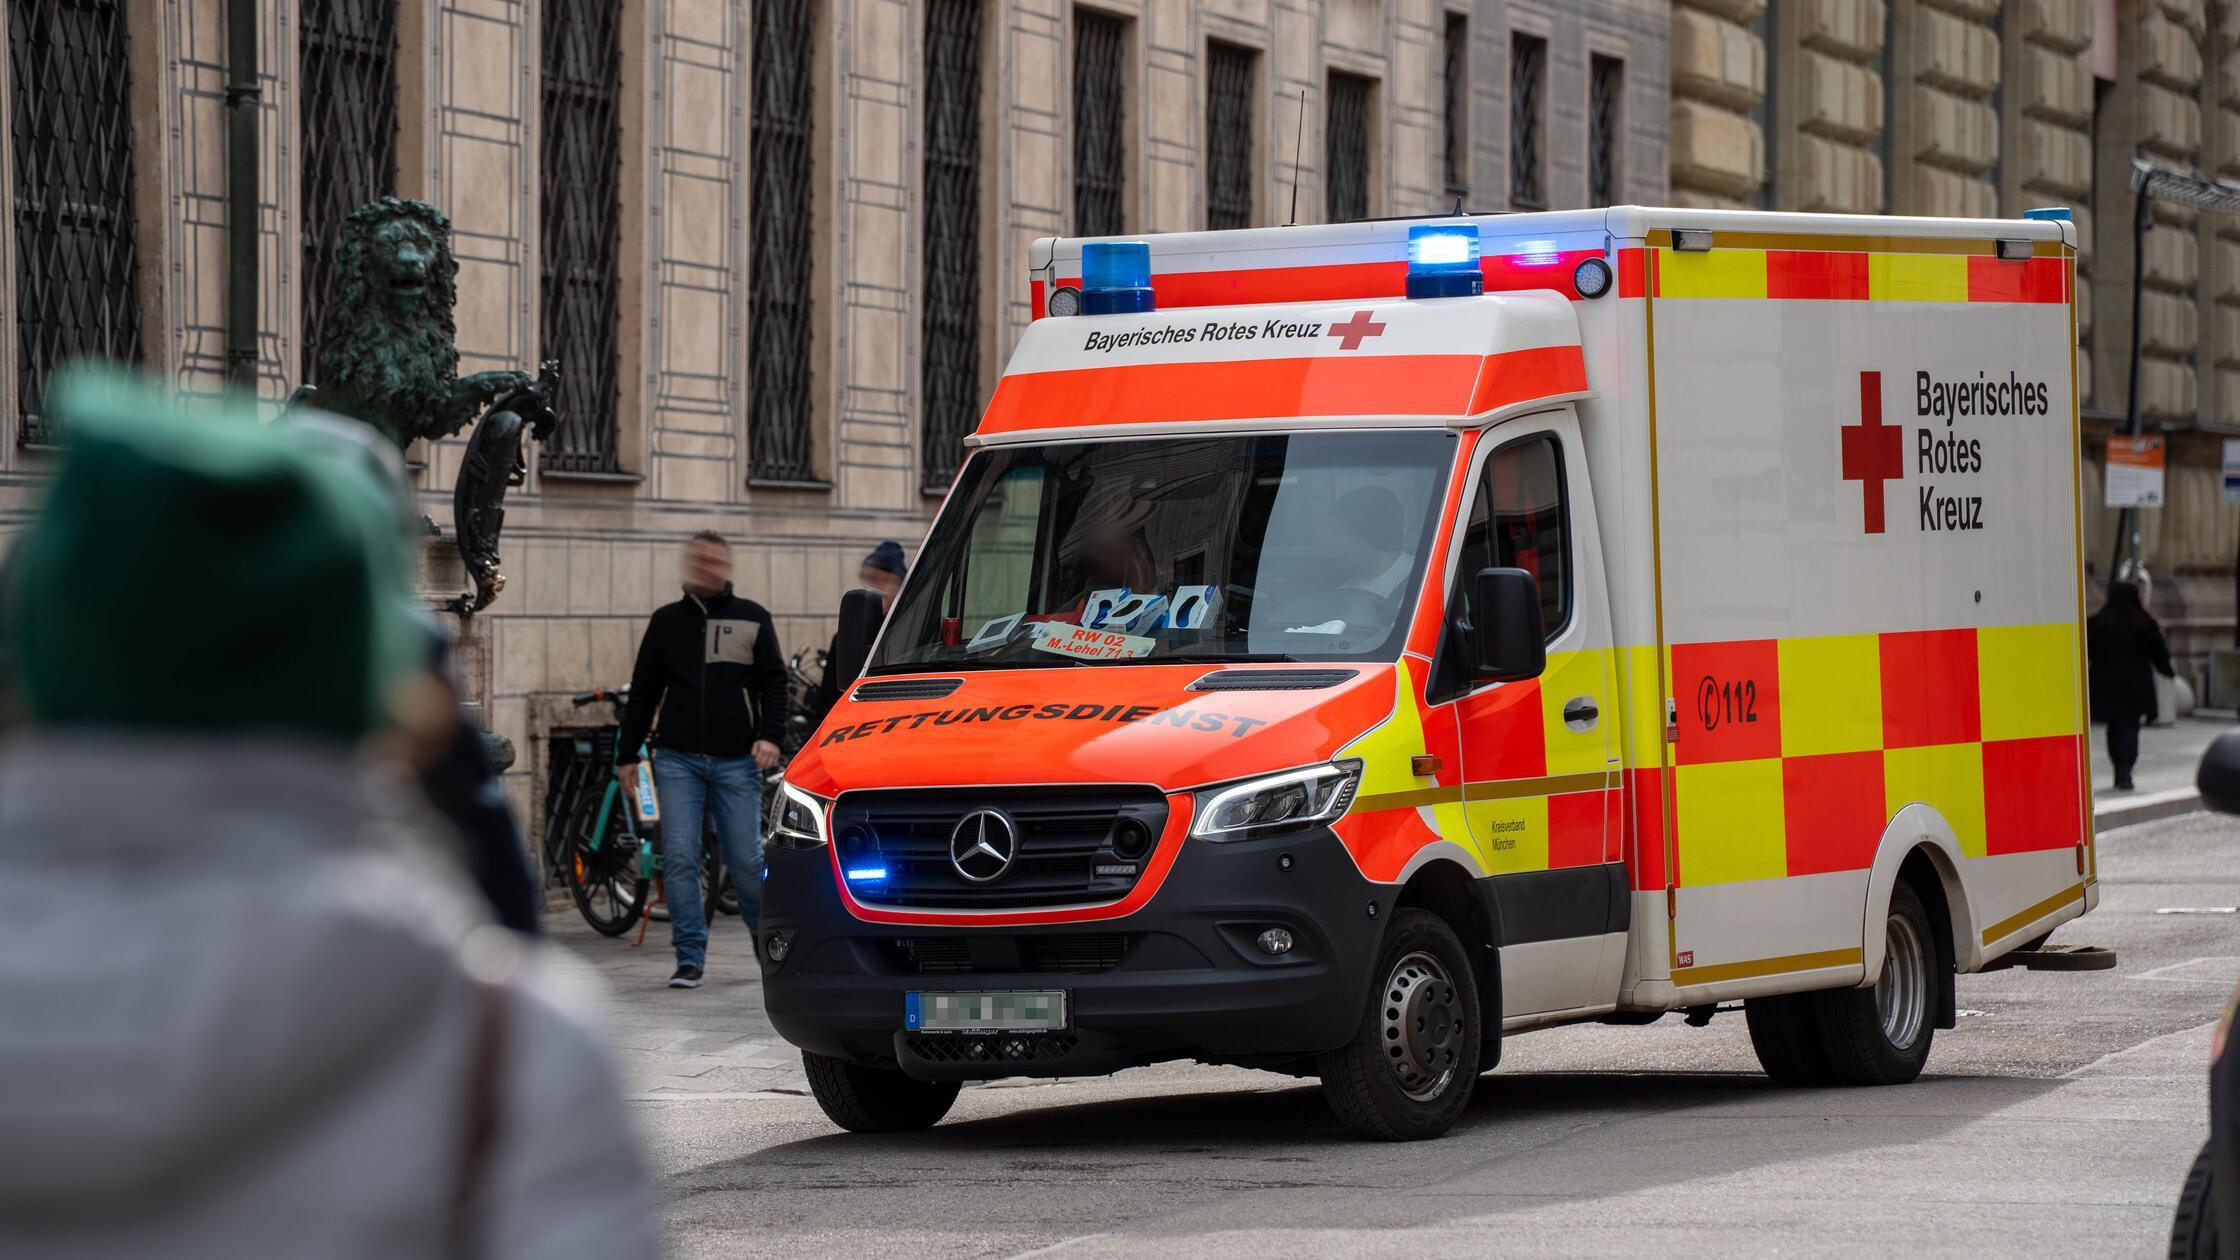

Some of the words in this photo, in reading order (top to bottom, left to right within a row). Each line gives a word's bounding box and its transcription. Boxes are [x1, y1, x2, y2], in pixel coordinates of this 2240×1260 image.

[1084, 325, 1197, 353] Bayerisches
[1200, 322, 1257, 343] Rotes
[1261, 319, 1322, 340] Kreuz
[1916, 371, 2049, 426] Bayerisches
[1918, 428, 1982, 474] Rotes
[1919, 486, 1983, 531] Kreuz
[1046, 637, 1105, 657] M.-Lehel
[1071, 629, 1102, 643] RW
[1103, 634, 1127, 647] 02
[1723, 679, 1757, 724] 112
[819, 703, 1267, 748] RETTUNGSDIENST
[1491, 818, 1526, 834] Kreisverband
[1492, 837, 1516, 851] München
[1678, 953, 1693, 965] WAS
[909, 1014, 916, 1023] D
